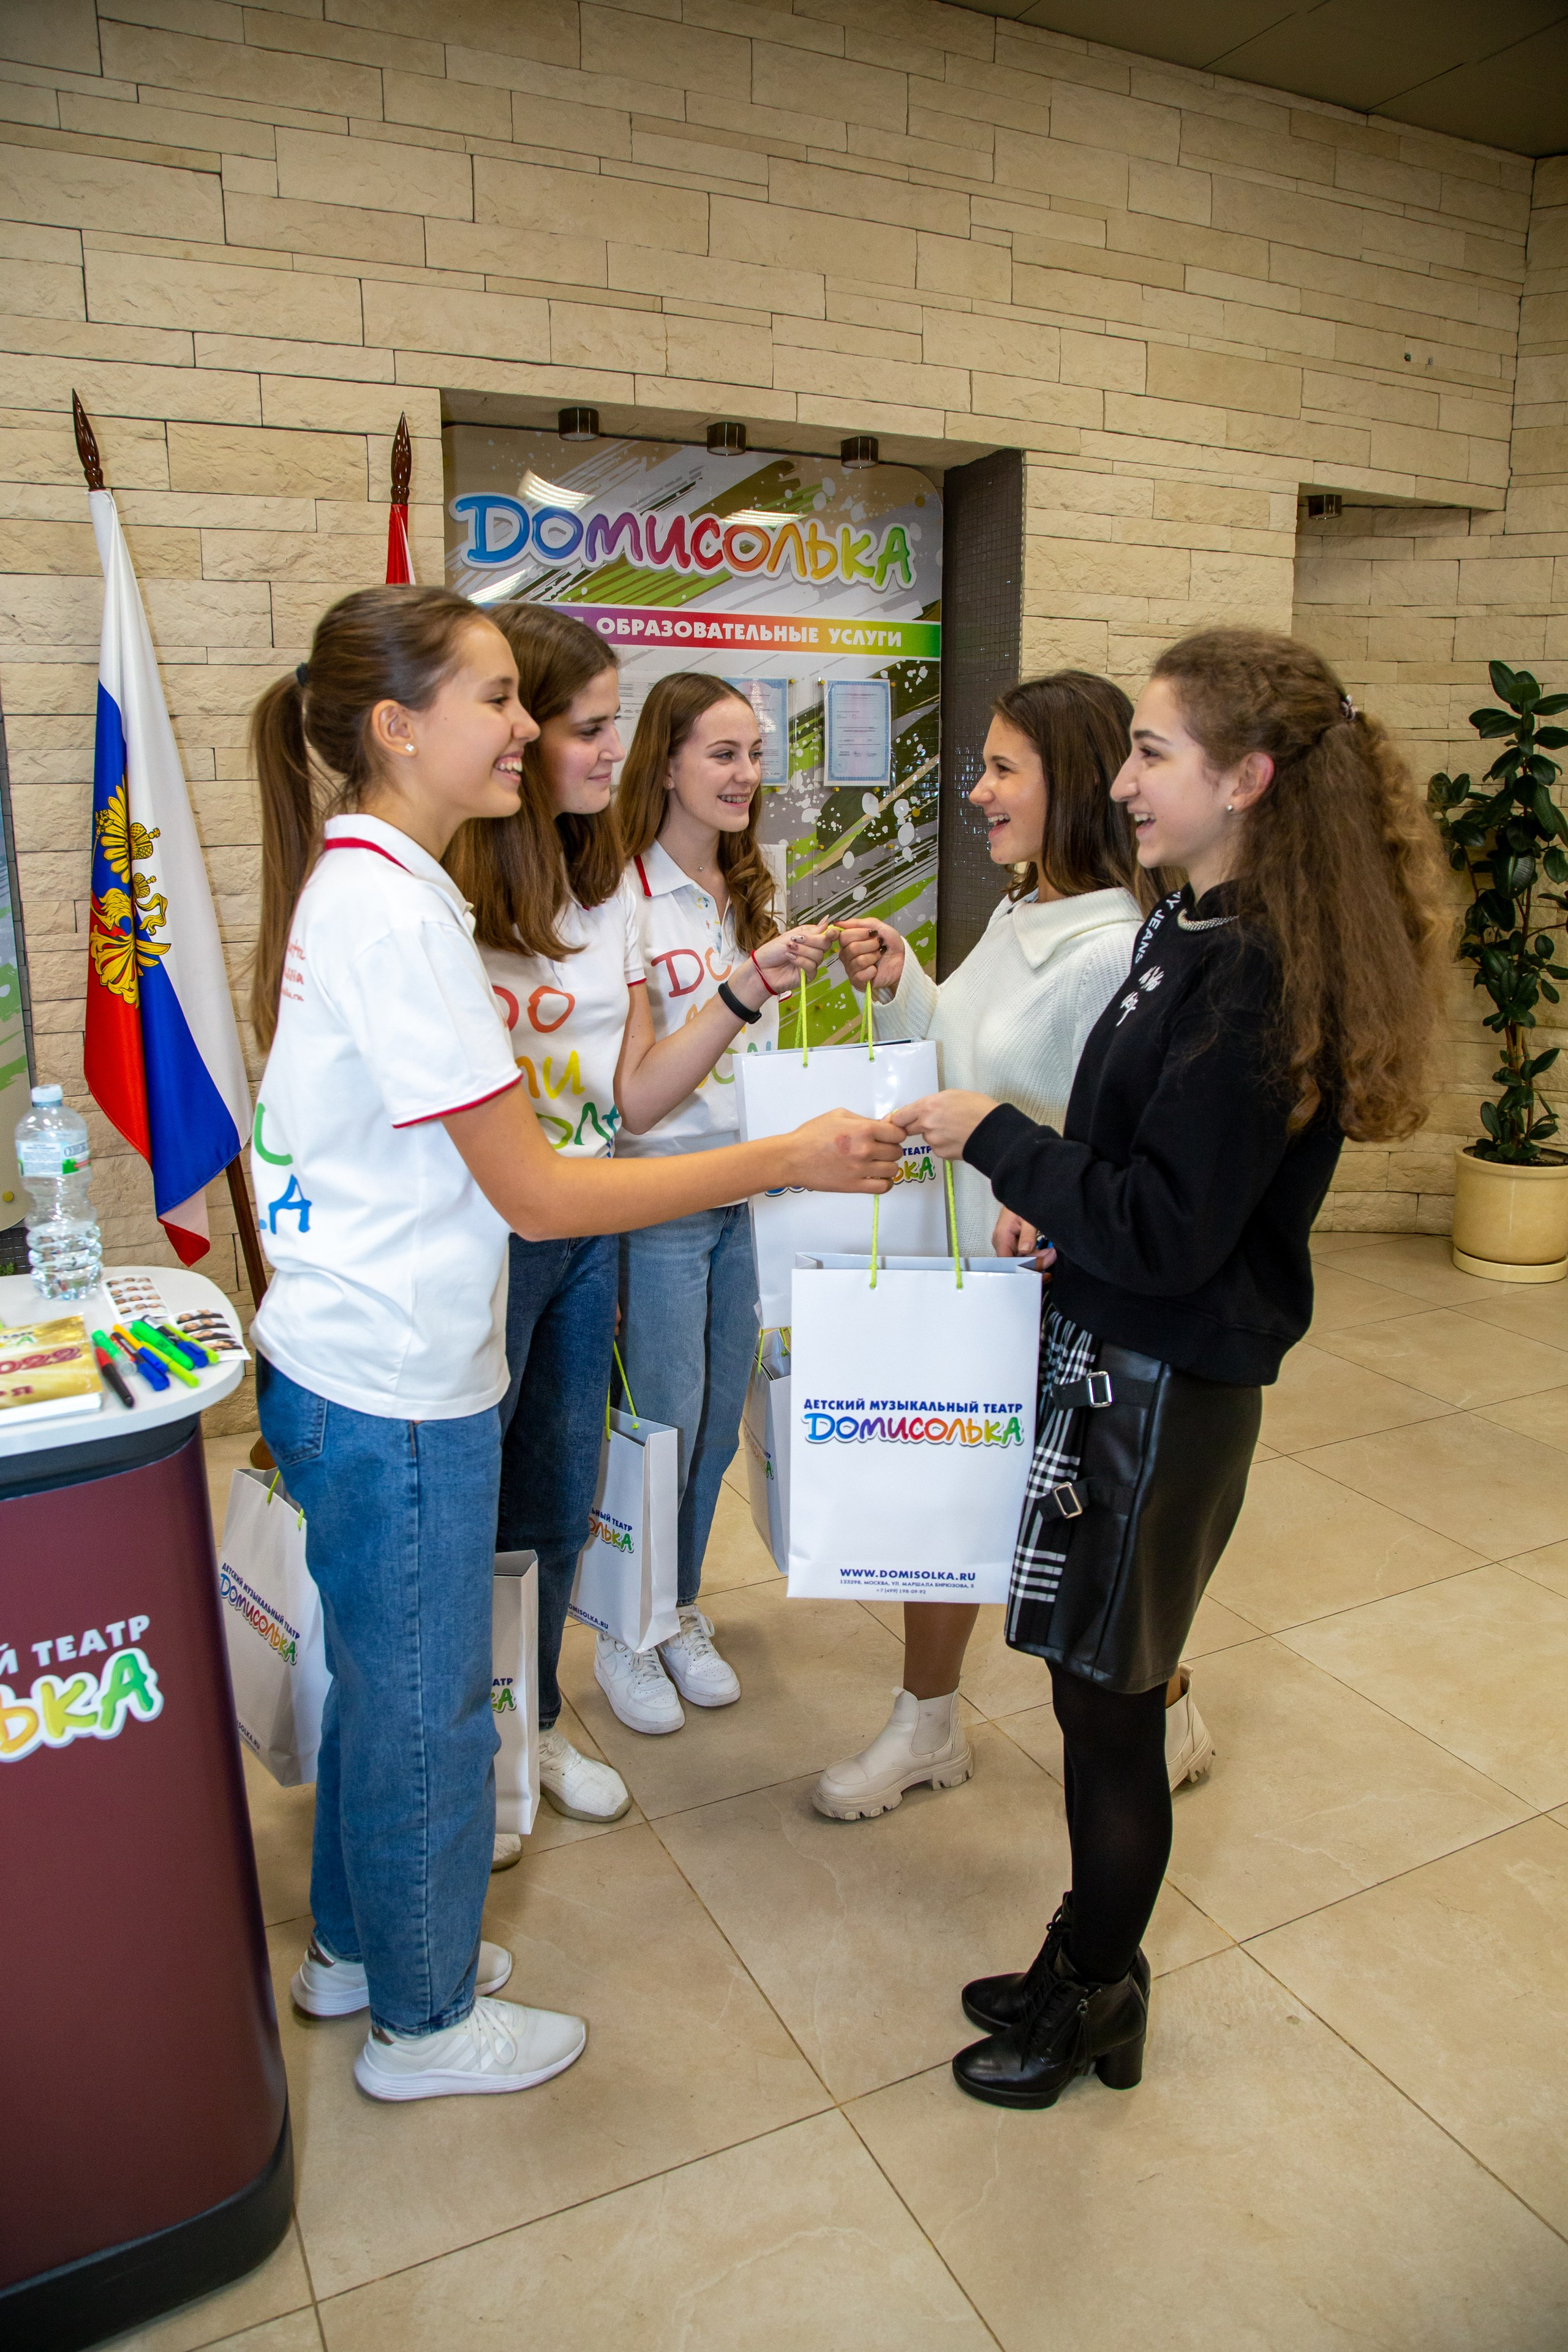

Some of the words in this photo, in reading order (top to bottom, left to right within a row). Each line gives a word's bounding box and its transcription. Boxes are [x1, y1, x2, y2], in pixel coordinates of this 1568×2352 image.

[596, 617, 819, 643] ОБРАЗОВАТЕЛЬНЫЕ
[829, 628, 902, 647] УСЛУГИ
[1135, 909, 1166, 965] JEANS
[0, 1347, 83, 1374] 022
[804, 1398, 865, 1410] ДЕТСКИЙ
[870, 1400, 979, 1414] МУЗЫКАЛЬНЫЙ
[983, 1403, 1023, 1414] ТЕАТР
[612, 1518, 633, 1532] ТЕАТР
[840, 1569, 976, 1581] WWW.DOMISOLKA.RU
[222, 1562, 244, 1588] ДЕТСКИЙ
[243, 1583, 284, 1625] МУЗЫКАЛЬНЫЙ
[284, 1621, 300, 1640] ТЕАТР
[568, 1603, 609, 1629] OMISOLKA.RU
[31, 1615, 151, 1667] ТЕАТР
[492, 1678, 513, 1686] АТР
